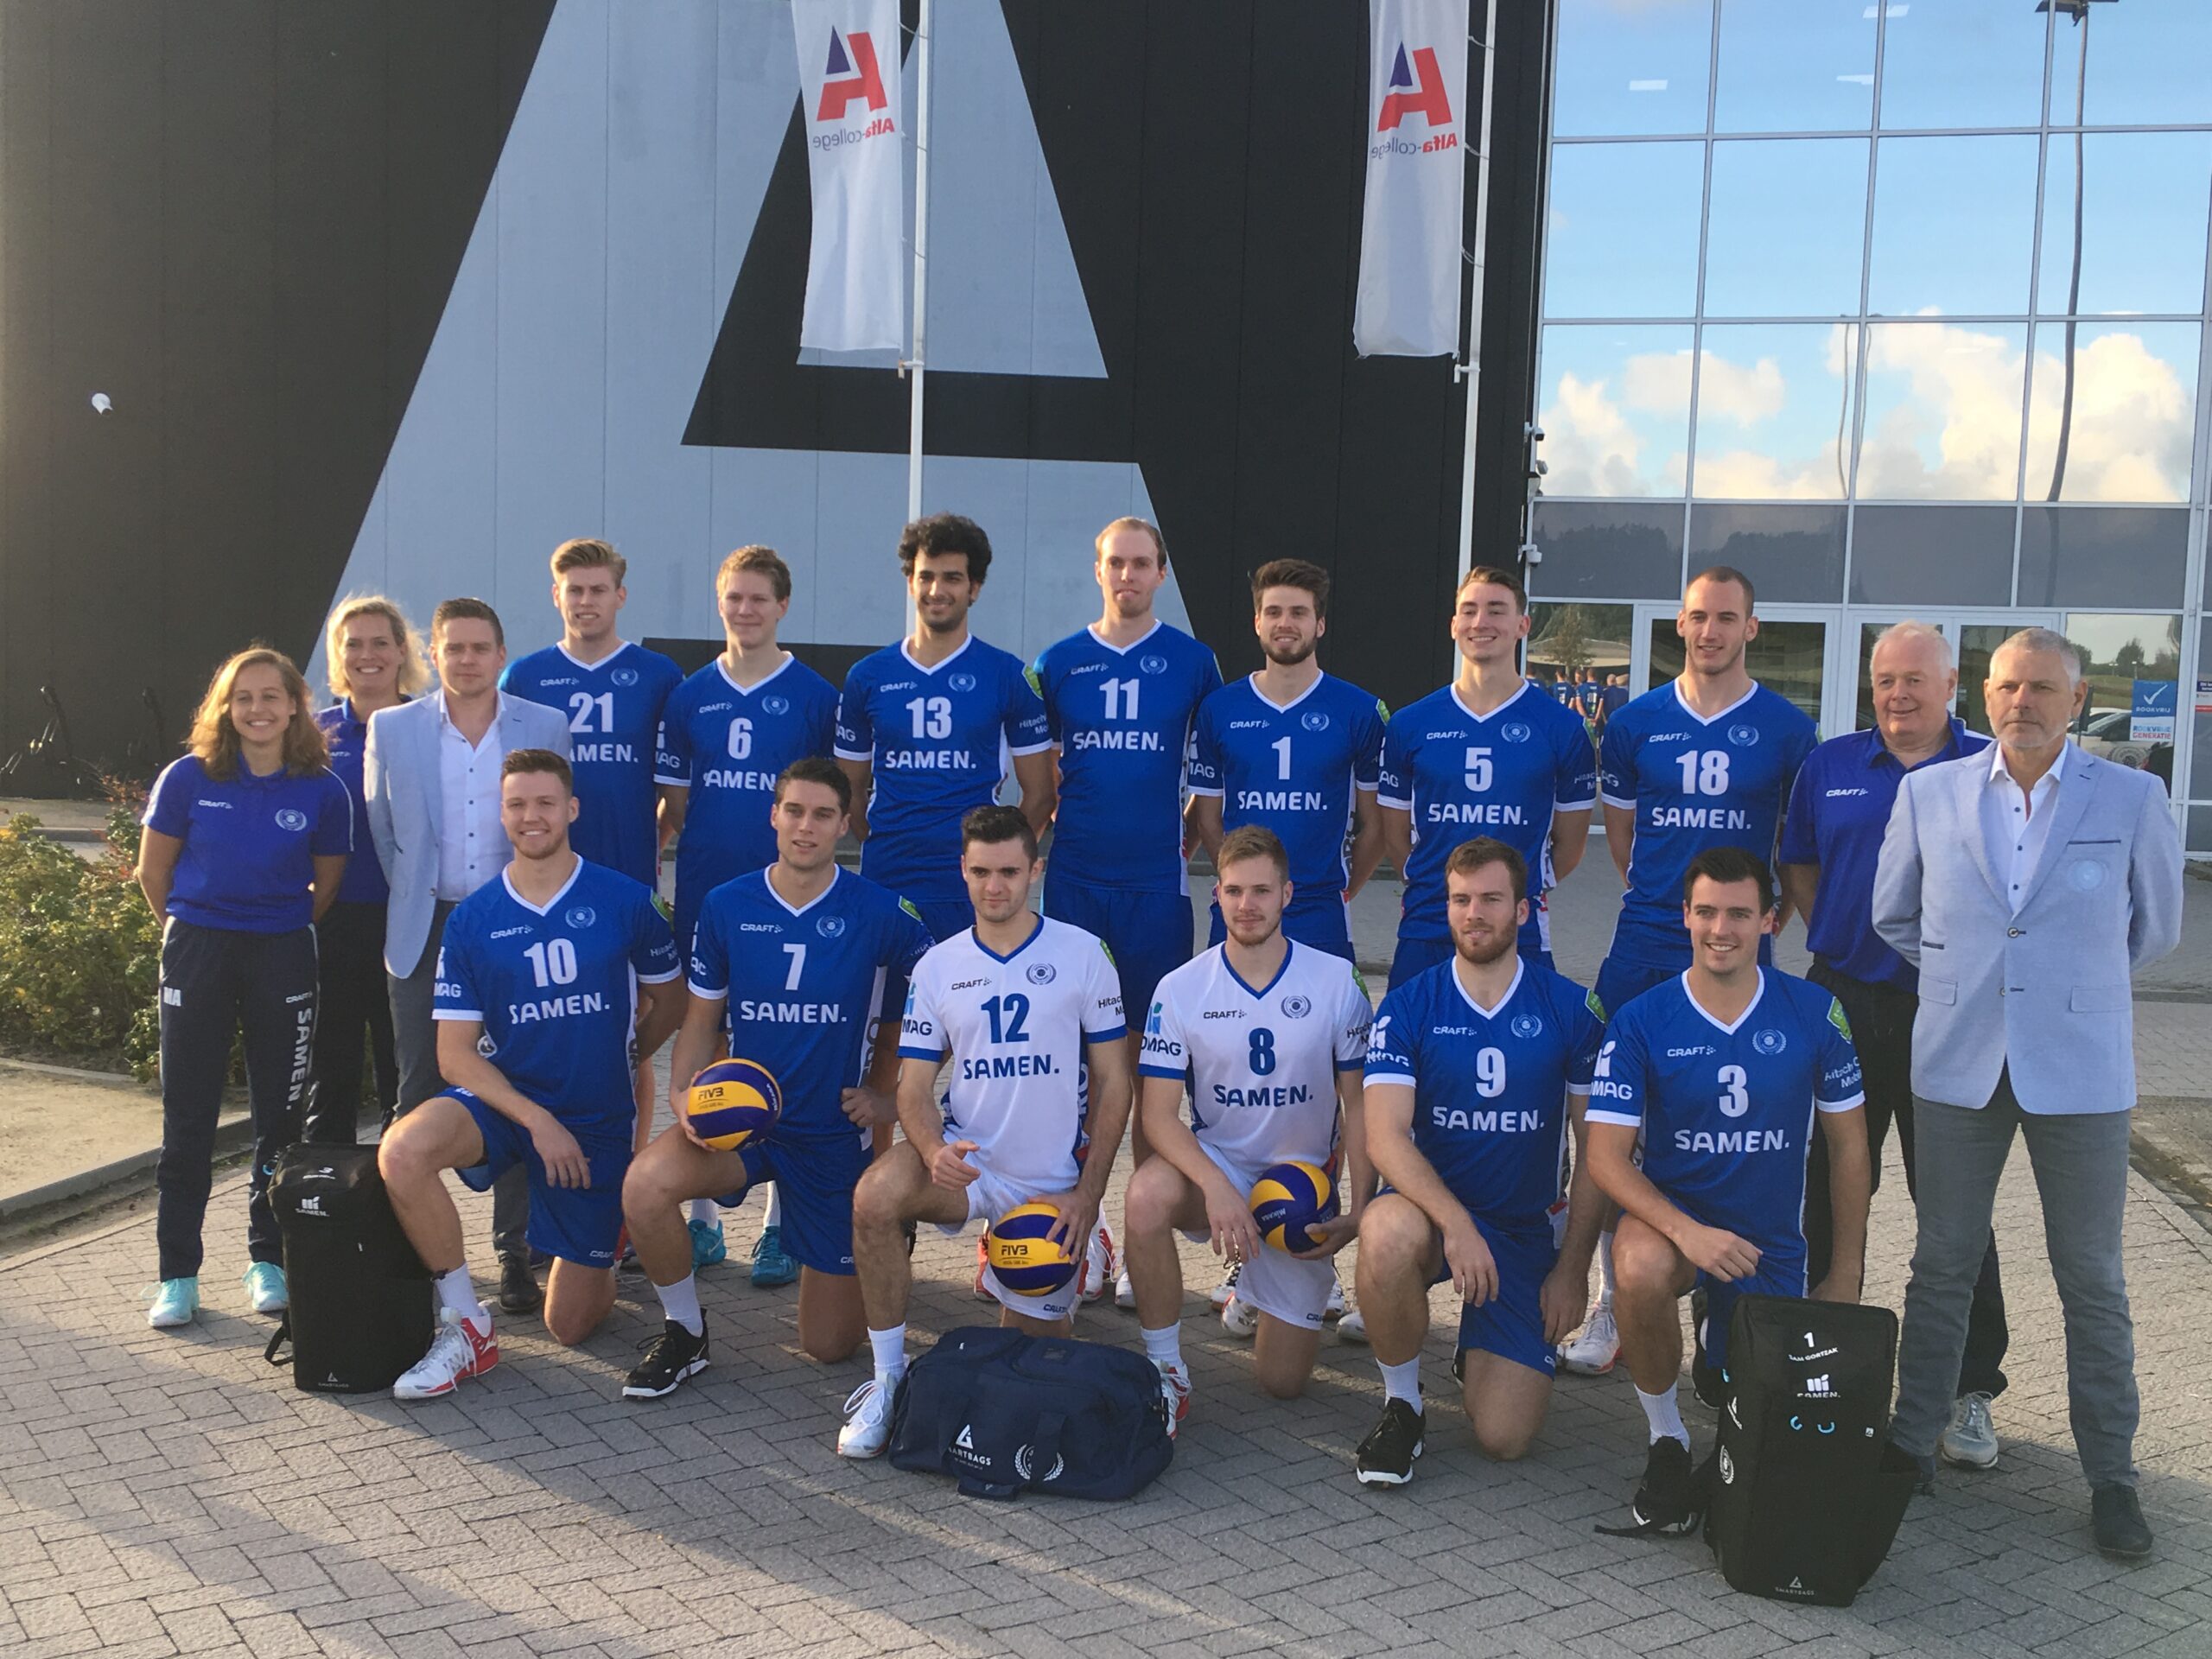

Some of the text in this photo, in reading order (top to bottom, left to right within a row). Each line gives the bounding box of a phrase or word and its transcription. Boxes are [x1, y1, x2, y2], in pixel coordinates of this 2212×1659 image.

[1071, 664, 1101, 675] CRAFT
[540, 677, 571, 686] CRAFT
[880, 682, 910, 692] CRAFT
[699, 702, 726, 713] CRAFT
[1099, 677, 1139, 720] 11
[569, 692, 613, 733] 21
[906, 696, 952, 740] 13
[728, 717, 753, 760] 6
[1072, 731, 1165, 752] SAMEN.
[1427, 731, 1459, 740] CRAFT
[1649, 733, 1682, 743] CRAFT
[570, 744, 639, 763] MEN.
[885, 750, 976, 769] SAMEN.
[1271, 736, 1291, 780] 1
[1465, 747, 1493, 792] 5
[1676, 750, 1730, 796] 18
[1237, 791, 1327, 810] SAMEN.
[1826, 788, 1859, 797] CRAFT
[1427, 804, 1529, 825] SAMEN.
[1651, 807, 1752, 830] SAMEN.
[491, 926, 524, 938] CRAFT
[741, 923, 774, 932] CRAFT
[524, 938, 577, 988] 10
[783, 943, 806, 990] 7
[951, 979, 983, 990] CRAFT
[509, 993, 610, 1025] SAMEN.
[741, 1001, 847, 1023] SAMEN.
[981, 993, 1030, 1044] 12
[1204, 1010, 1237, 1019] CRAFT
[1433, 1026, 1468, 1035] CRAFT
[286, 1007, 312, 1110] SAMEN.
[1249, 1027, 1276, 1076] 8
[1667, 1046, 1706, 1057] CRAFT
[963, 1054, 1059, 1080] SAMEN.
[1475, 1046, 1506, 1097] 9
[1214, 1084, 1313, 1108] SAMEN.
[1718, 1065, 1749, 1117] 3
[1432, 1106, 1545, 1132] SAMEN.
[1675, 1128, 1789, 1154] SAMEN.
[1804, 1332, 1815, 1348] 1
